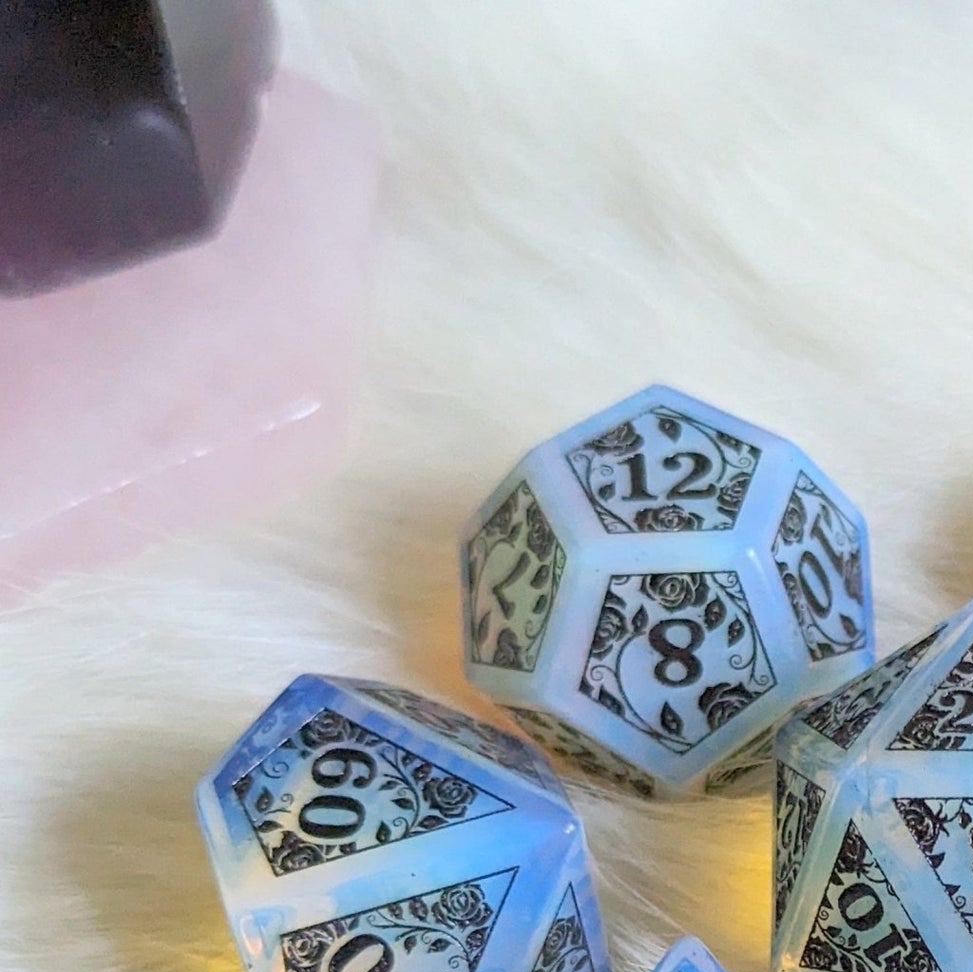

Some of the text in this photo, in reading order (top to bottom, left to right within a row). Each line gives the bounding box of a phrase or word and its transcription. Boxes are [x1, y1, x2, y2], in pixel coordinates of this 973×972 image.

[620, 452, 714, 501] 12
[798, 519, 846, 618] 10
[647, 619, 704, 687] 8
[837, 882, 906, 967] 10
